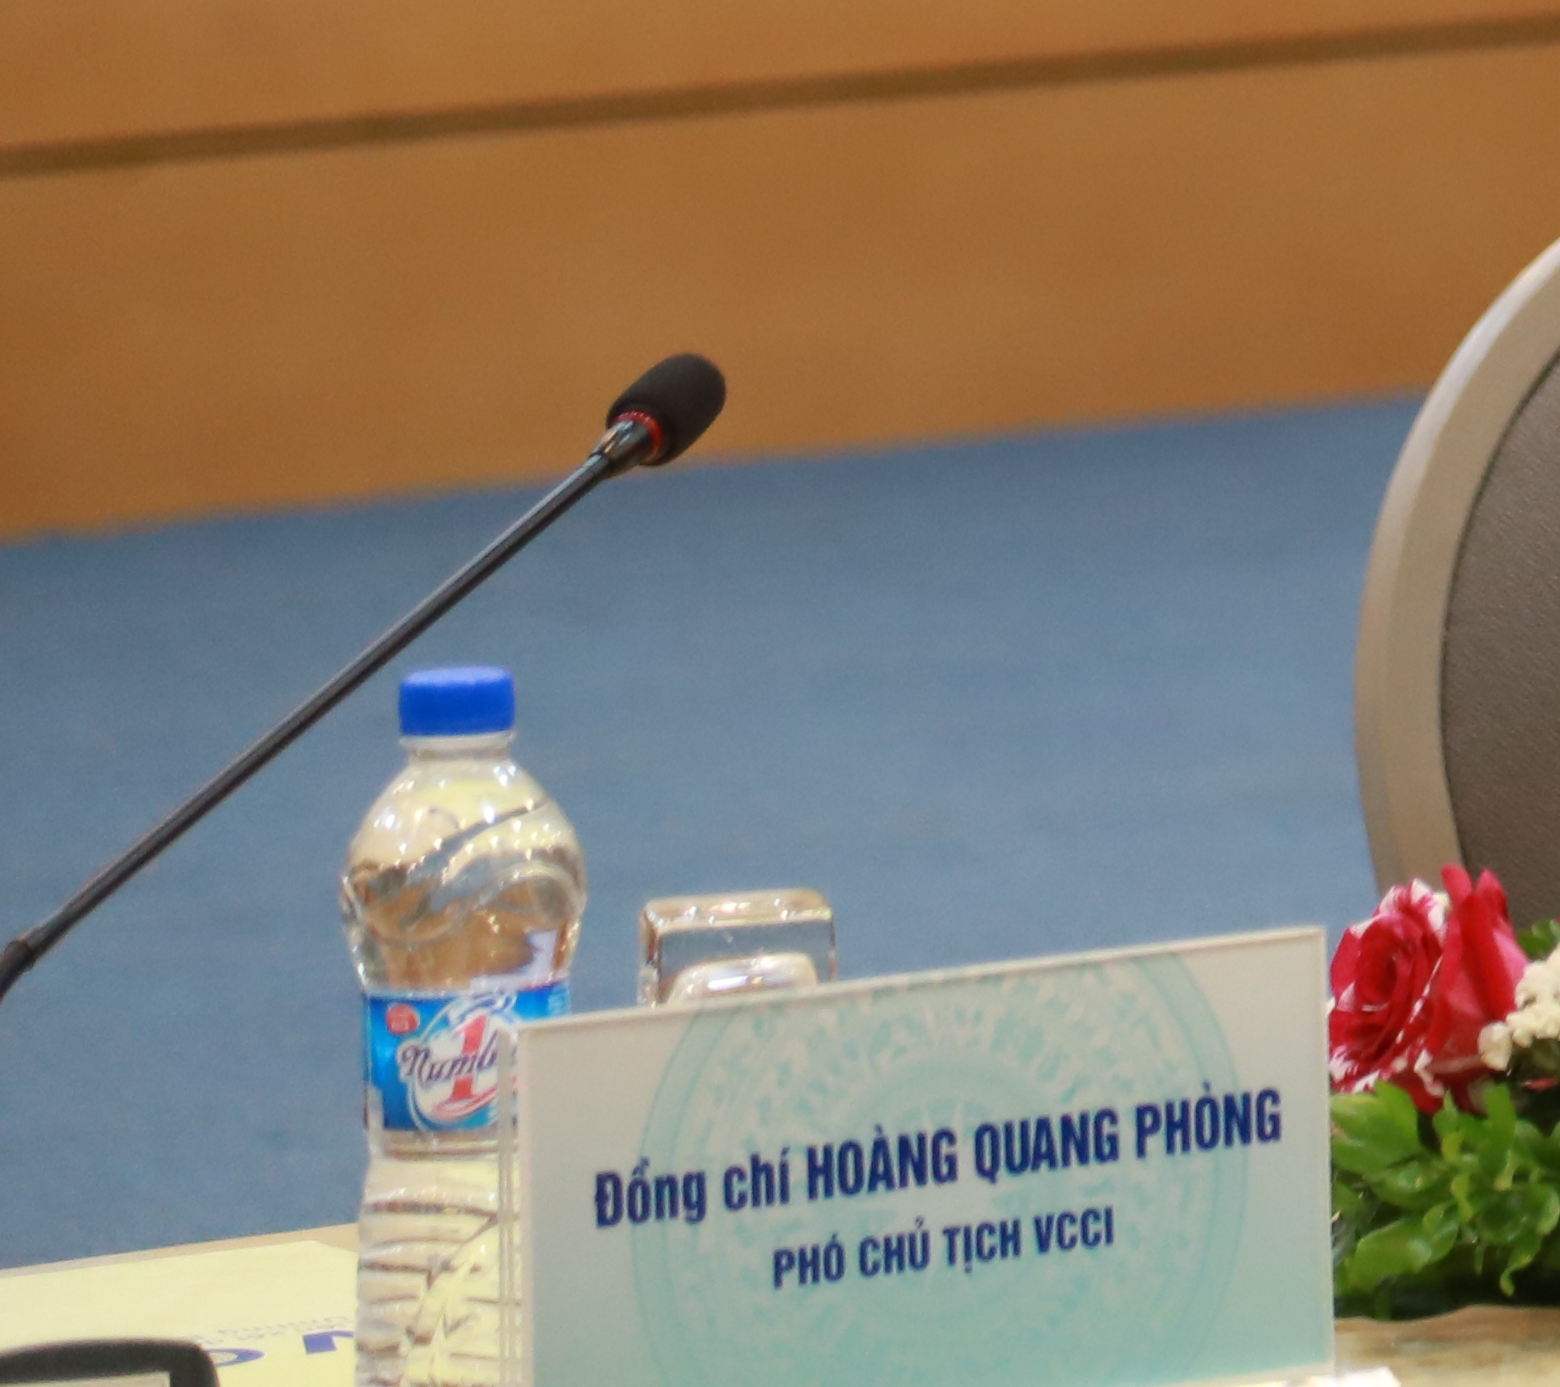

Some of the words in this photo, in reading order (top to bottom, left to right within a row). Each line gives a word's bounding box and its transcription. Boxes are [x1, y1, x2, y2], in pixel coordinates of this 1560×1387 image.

[594, 1157, 707, 1228] Đồng
[723, 1147, 791, 1211] chí
[806, 1124, 959, 1201] HOÀNG
[974, 1107, 1120, 1185] QUANG
[1134, 1080, 1282, 1159] PHÒNG
[773, 1232, 846, 1290] PHÓ
[859, 1216, 931, 1277] CHỦ
[942, 1218, 1022, 1274] TỊCH
[1032, 1206, 1114, 1255] VCCI
